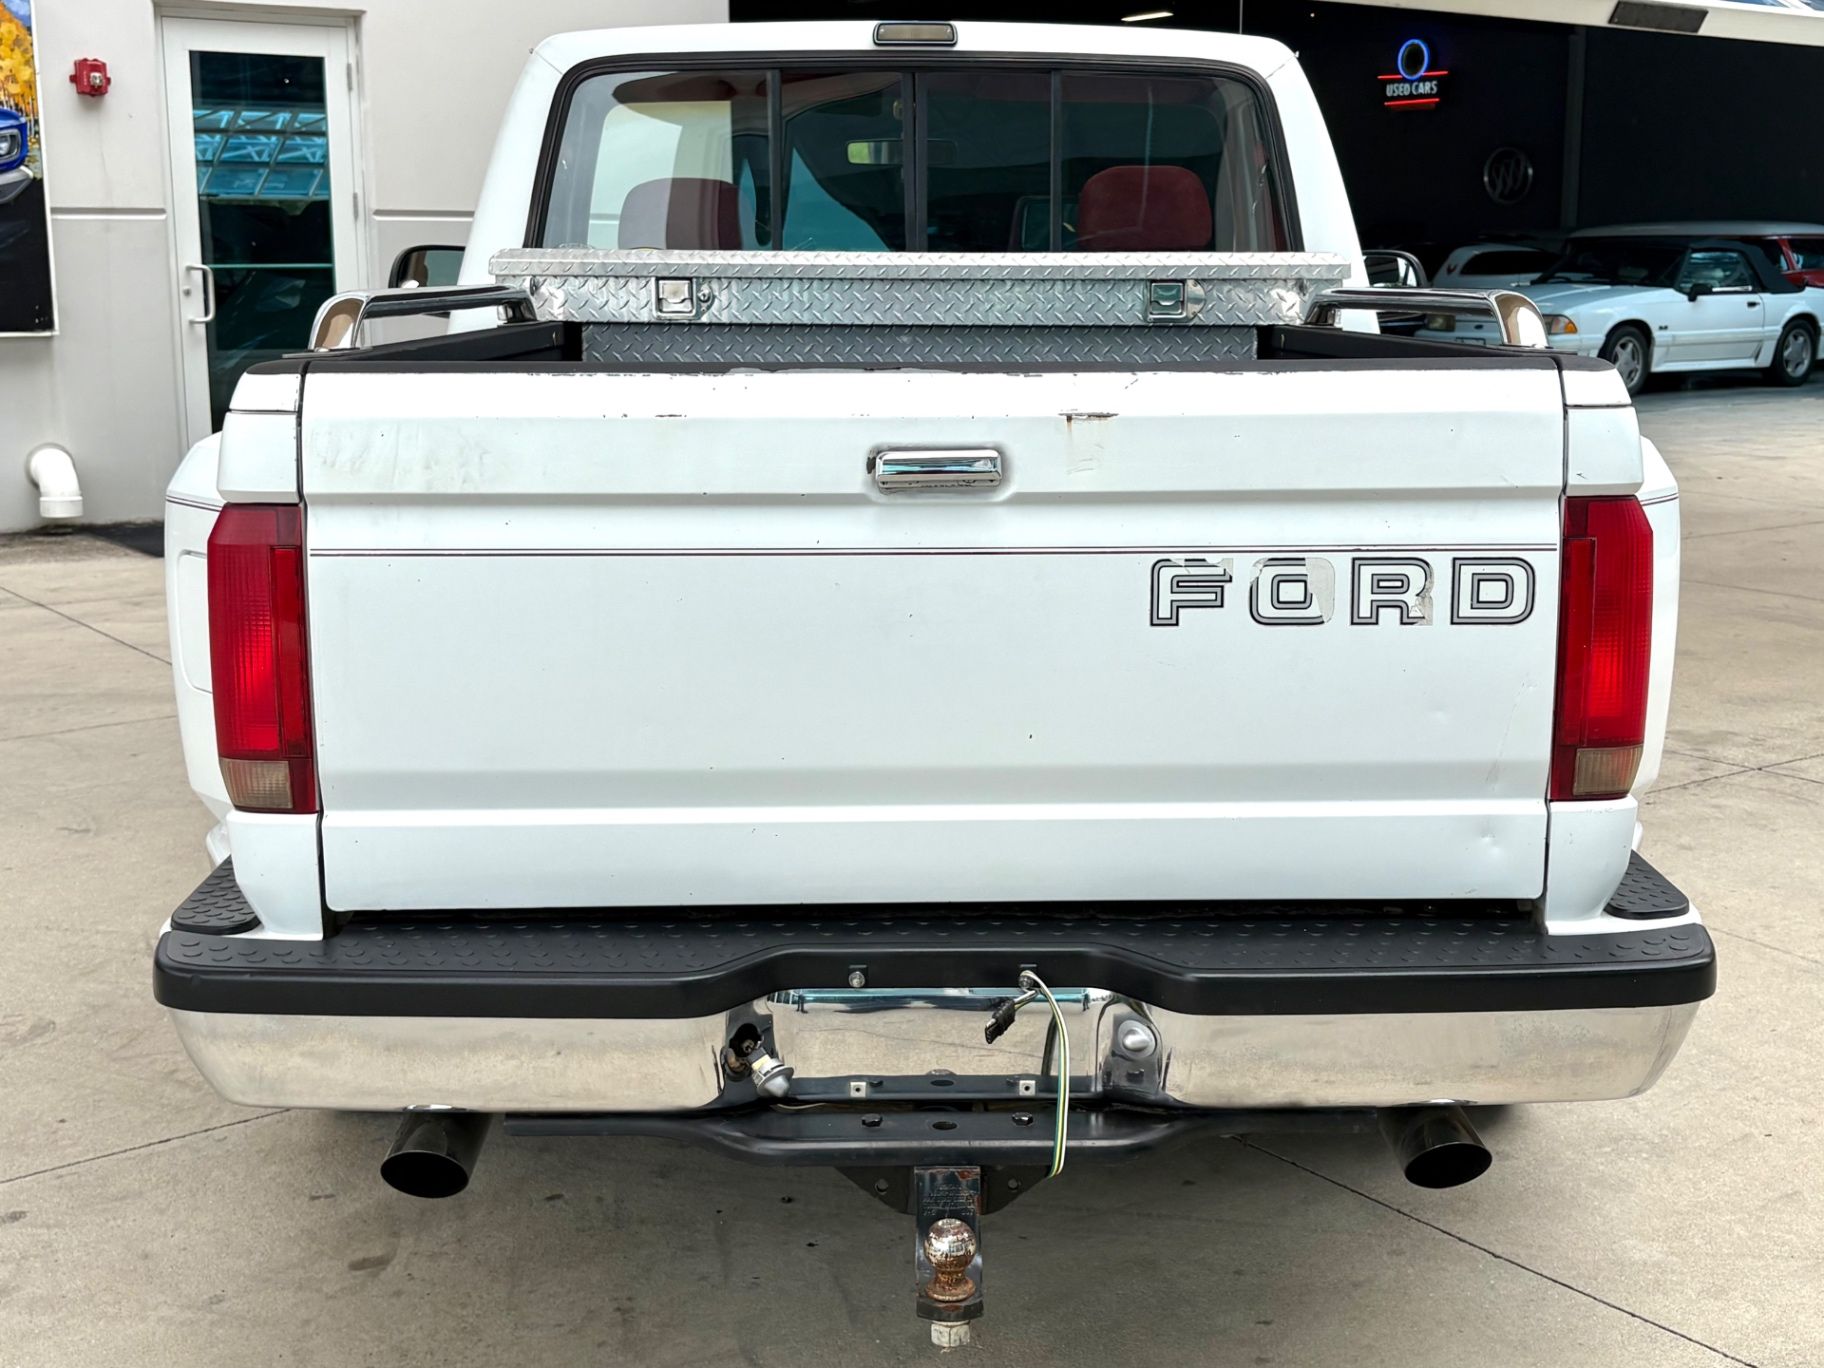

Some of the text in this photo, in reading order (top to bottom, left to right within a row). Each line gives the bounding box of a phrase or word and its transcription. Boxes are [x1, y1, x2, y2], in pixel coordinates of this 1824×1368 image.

[1385, 80, 1438, 97] USED CARS
[1150, 556, 1536, 627] FORD
